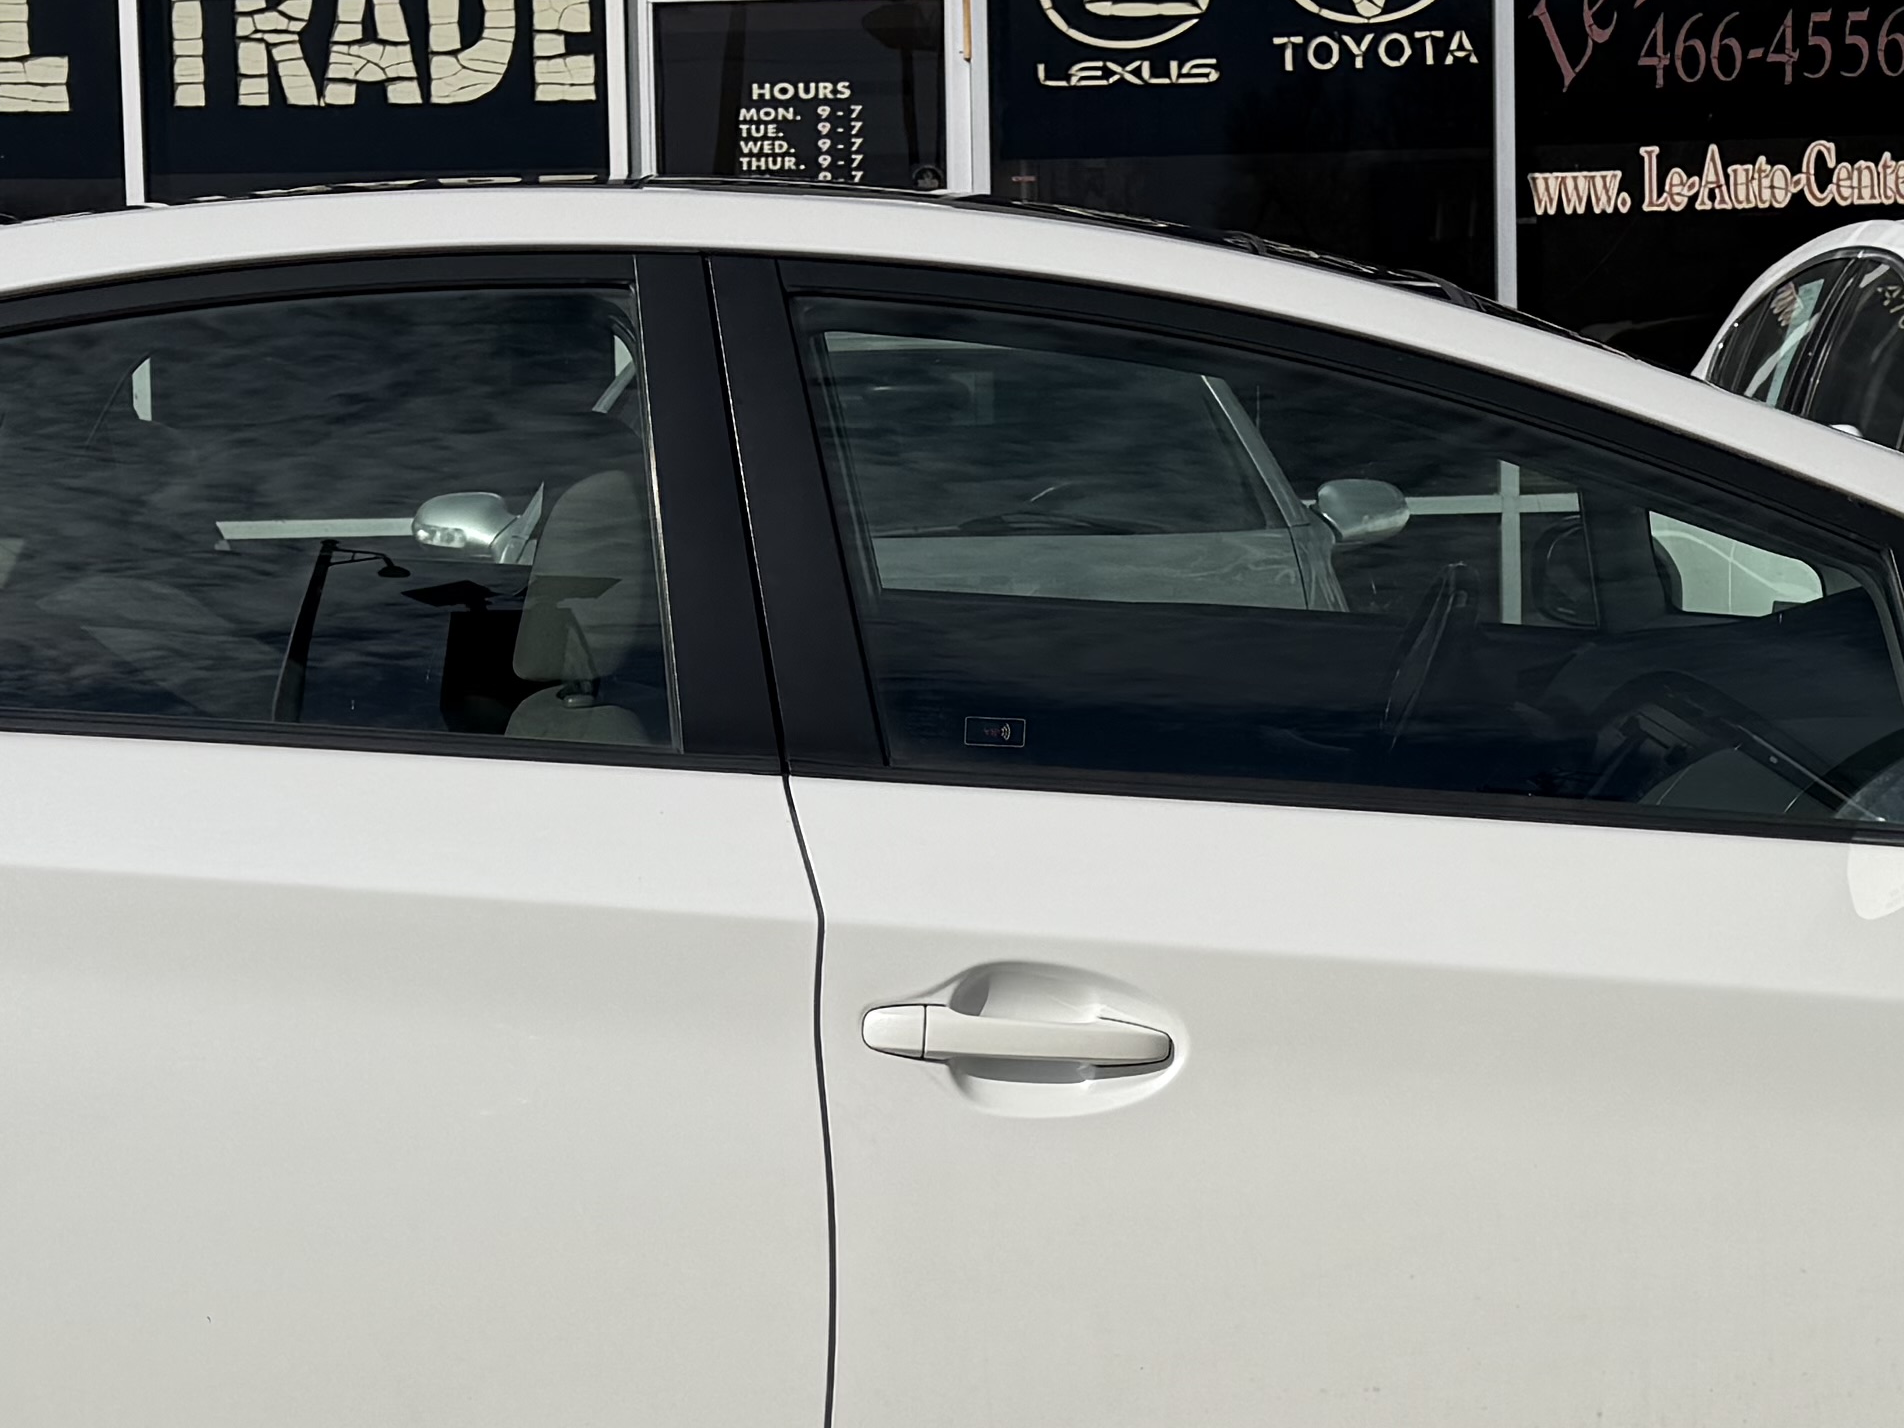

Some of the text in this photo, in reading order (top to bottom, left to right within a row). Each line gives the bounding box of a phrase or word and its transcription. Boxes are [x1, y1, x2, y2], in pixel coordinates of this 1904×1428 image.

[1273, 30, 1479, 72] TOYOTA
[1037, 57, 1220, 87] LEXUS
[751, 81, 852, 100] HOURS
[738, 108, 801, 121] MON.
[817, 105, 831, 119] 9
[850, 105, 863, 119] 7
[739, 124, 784, 137] TUE.
[817, 122, 831, 135] 9
[850, 121, 863, 135] 7
[740, 141, 796, 154] WED.
[817, 138, 832, 152] 9
[851, 137, 864, 151] 7
[739, 157, 806, 170] THUR.
[817, 154, 832, 168] 9
[851, 154, 864, 168] 7
